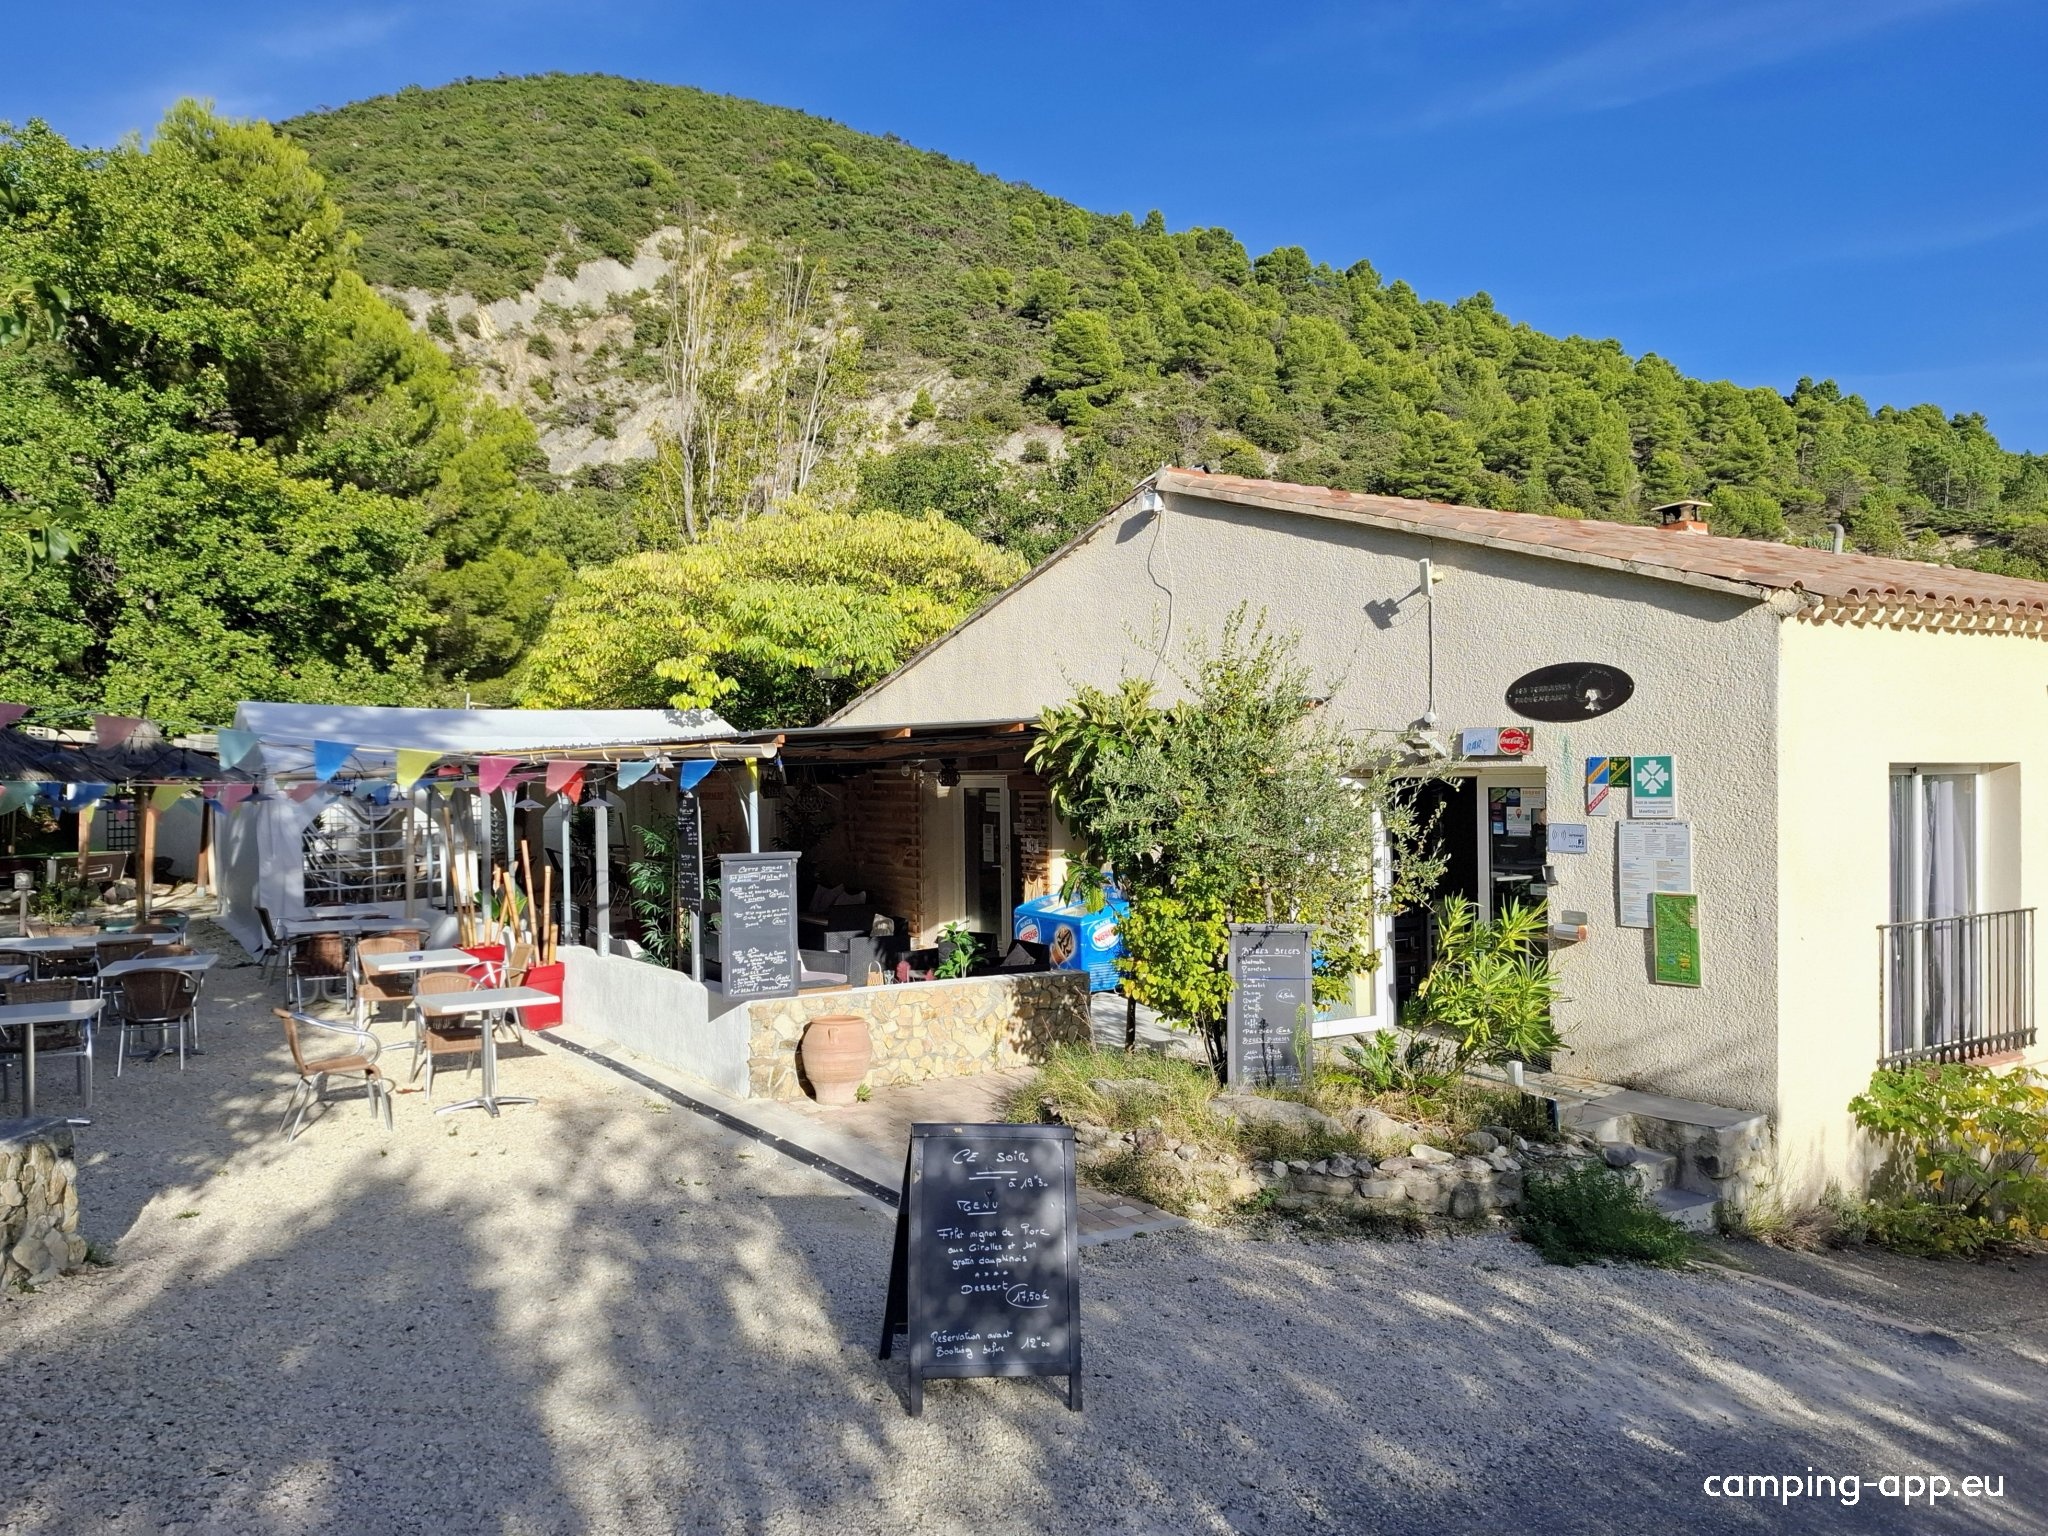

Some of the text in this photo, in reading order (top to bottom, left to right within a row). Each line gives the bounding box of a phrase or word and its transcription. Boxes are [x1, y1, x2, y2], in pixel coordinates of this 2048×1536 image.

[952, 1149, 979, 1164] CE
[957, 1200, 998, 1211] MENU
[969, 1231, 997, 1243] mignon
[1001, 1227, 1015, 1237] de
[968, 1243, 1003, 1252] Girolles
[1007, 1241, 1016, 1250] et
[952, 1254, 1028, 1270] gratin dauphinois
[960, 1280, 1009, 1295] Dessert
[987, 1330, 1013, 1339] avant
[935, 1345, 974, 1360] Booking
